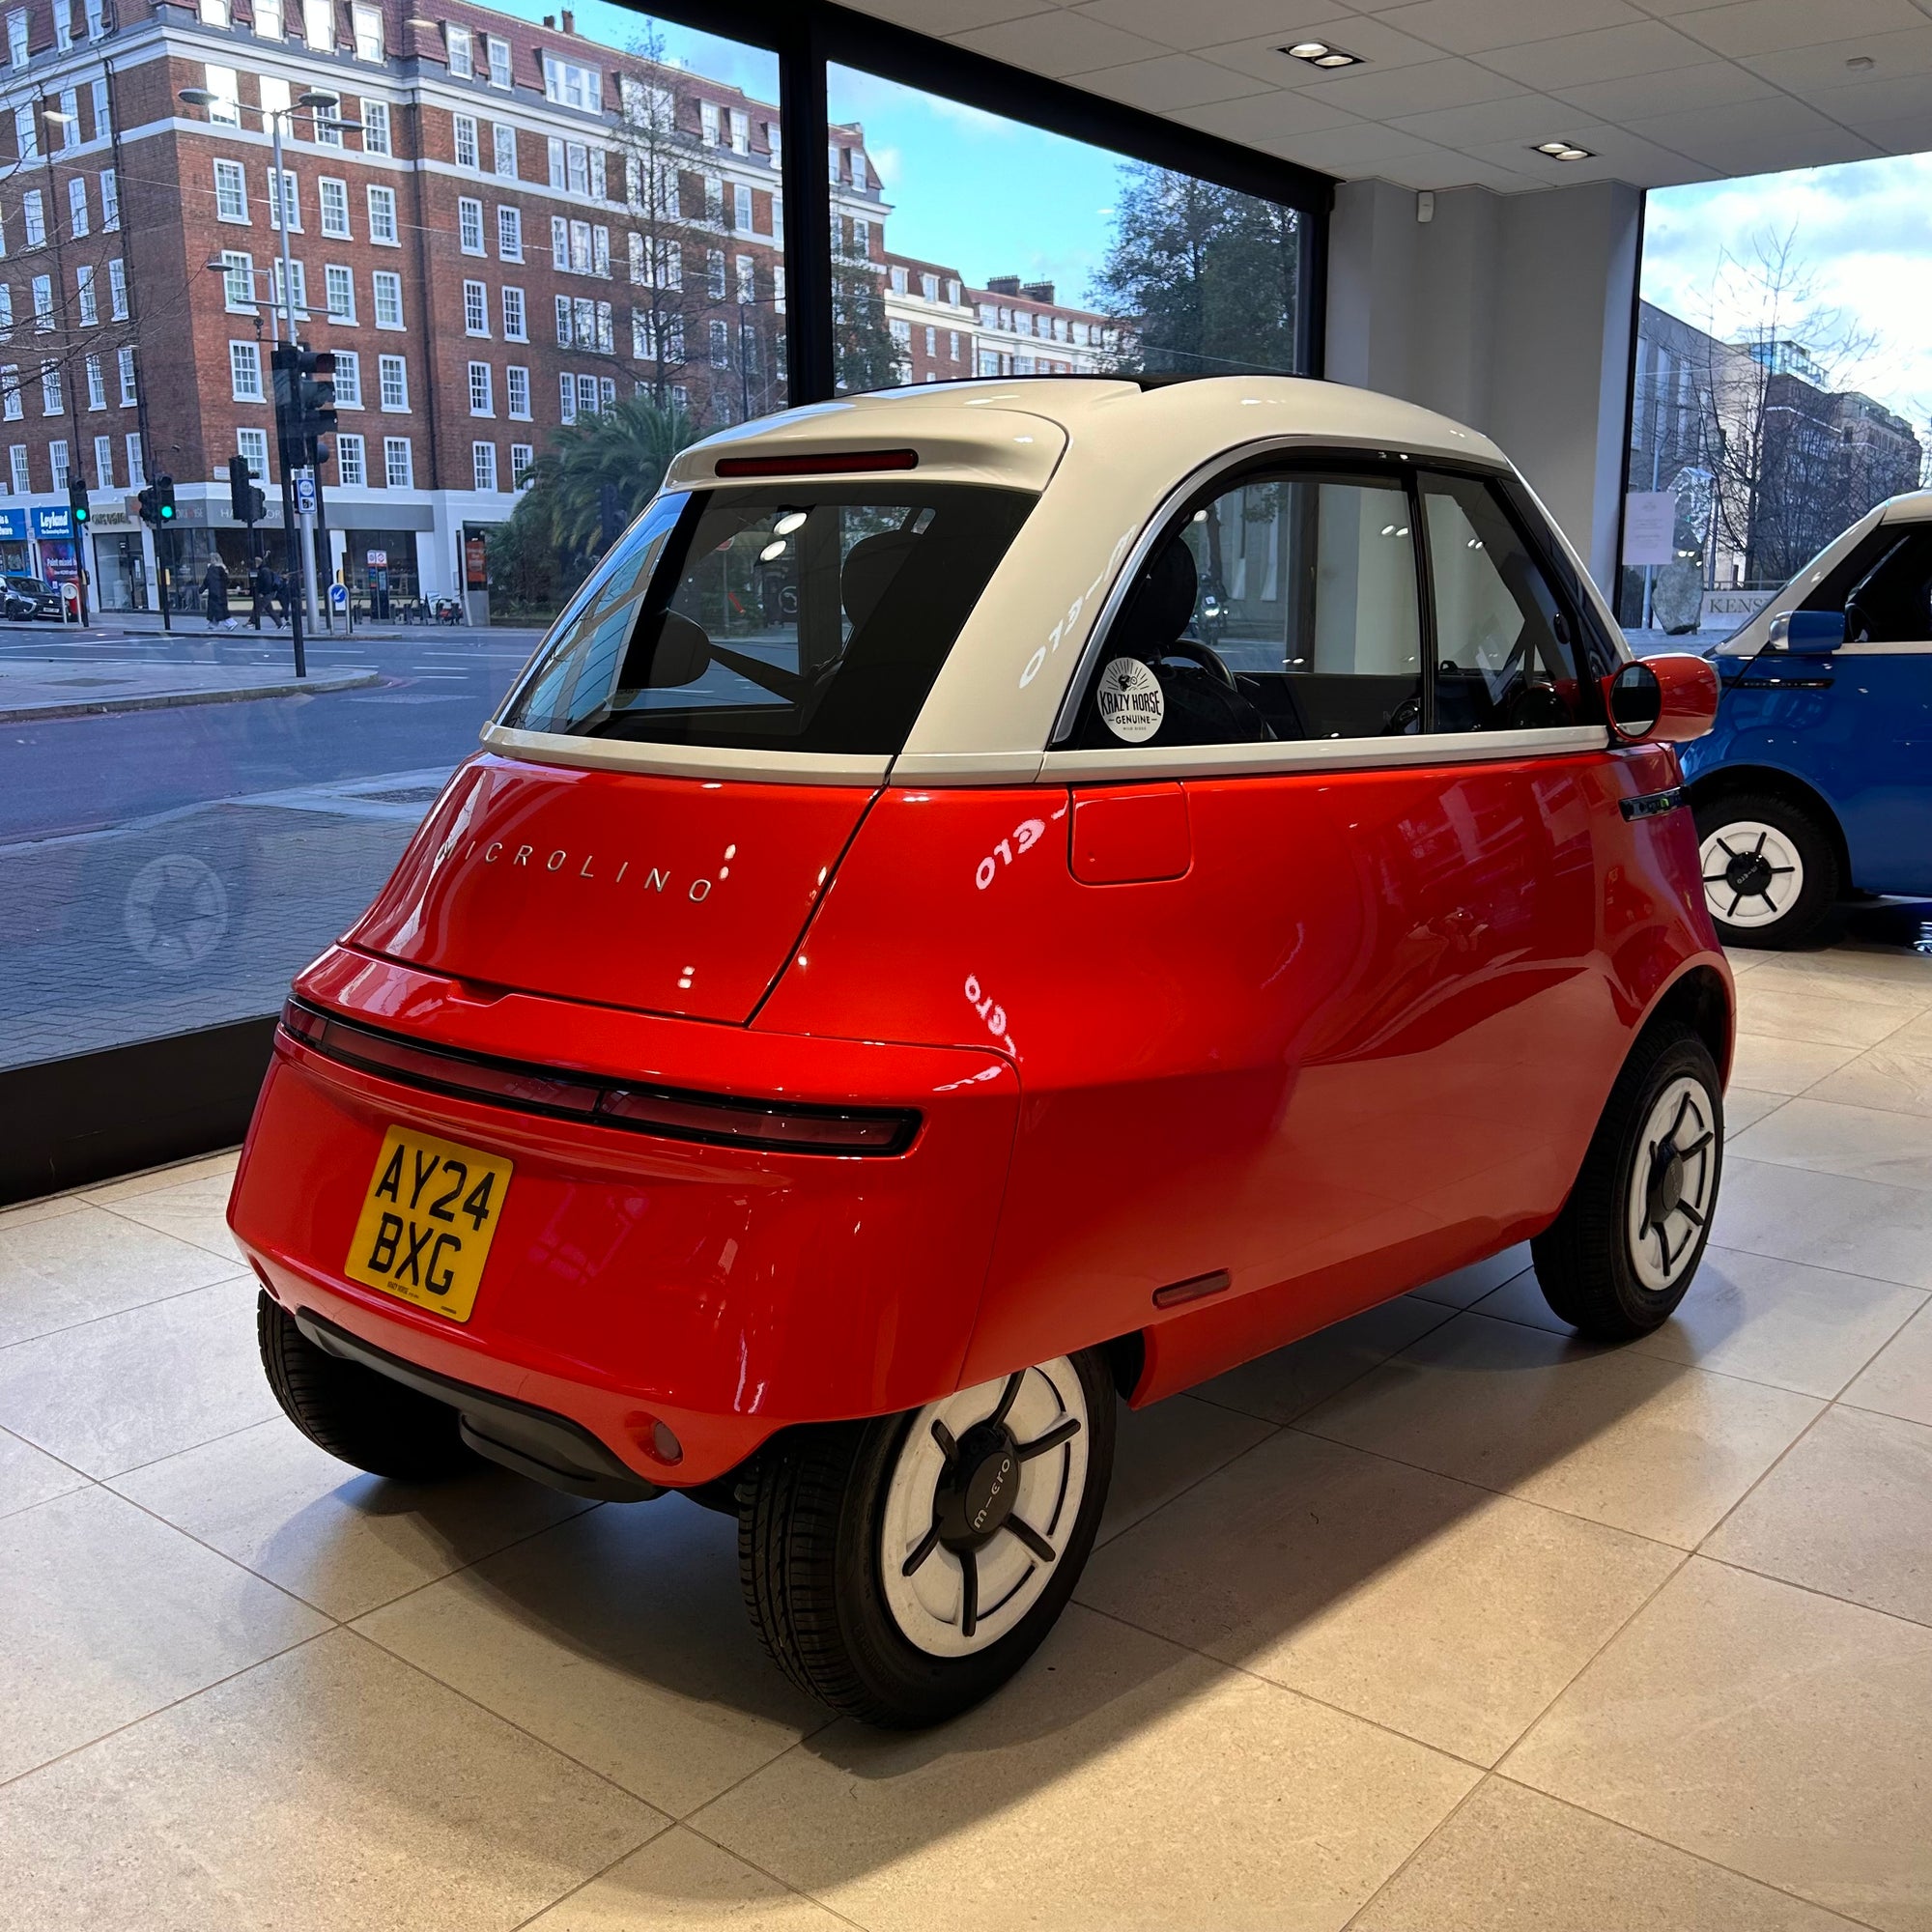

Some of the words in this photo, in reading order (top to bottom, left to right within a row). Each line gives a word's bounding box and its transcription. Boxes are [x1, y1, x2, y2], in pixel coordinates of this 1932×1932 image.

[41, 510, 68, 529] Leyland
[1709, 598, 1770, 613] KENS
[1099, 691, 1130, 716] KRAZY
[1132, 691, 1161, 716] HORSE
[1116, 715, 1151, 724] GENUINE
[438, 839, 712, 902] MICROLINO
[375, 1144, 496, 1232] AY24
[368, 1211, 462, 1295] BXG
